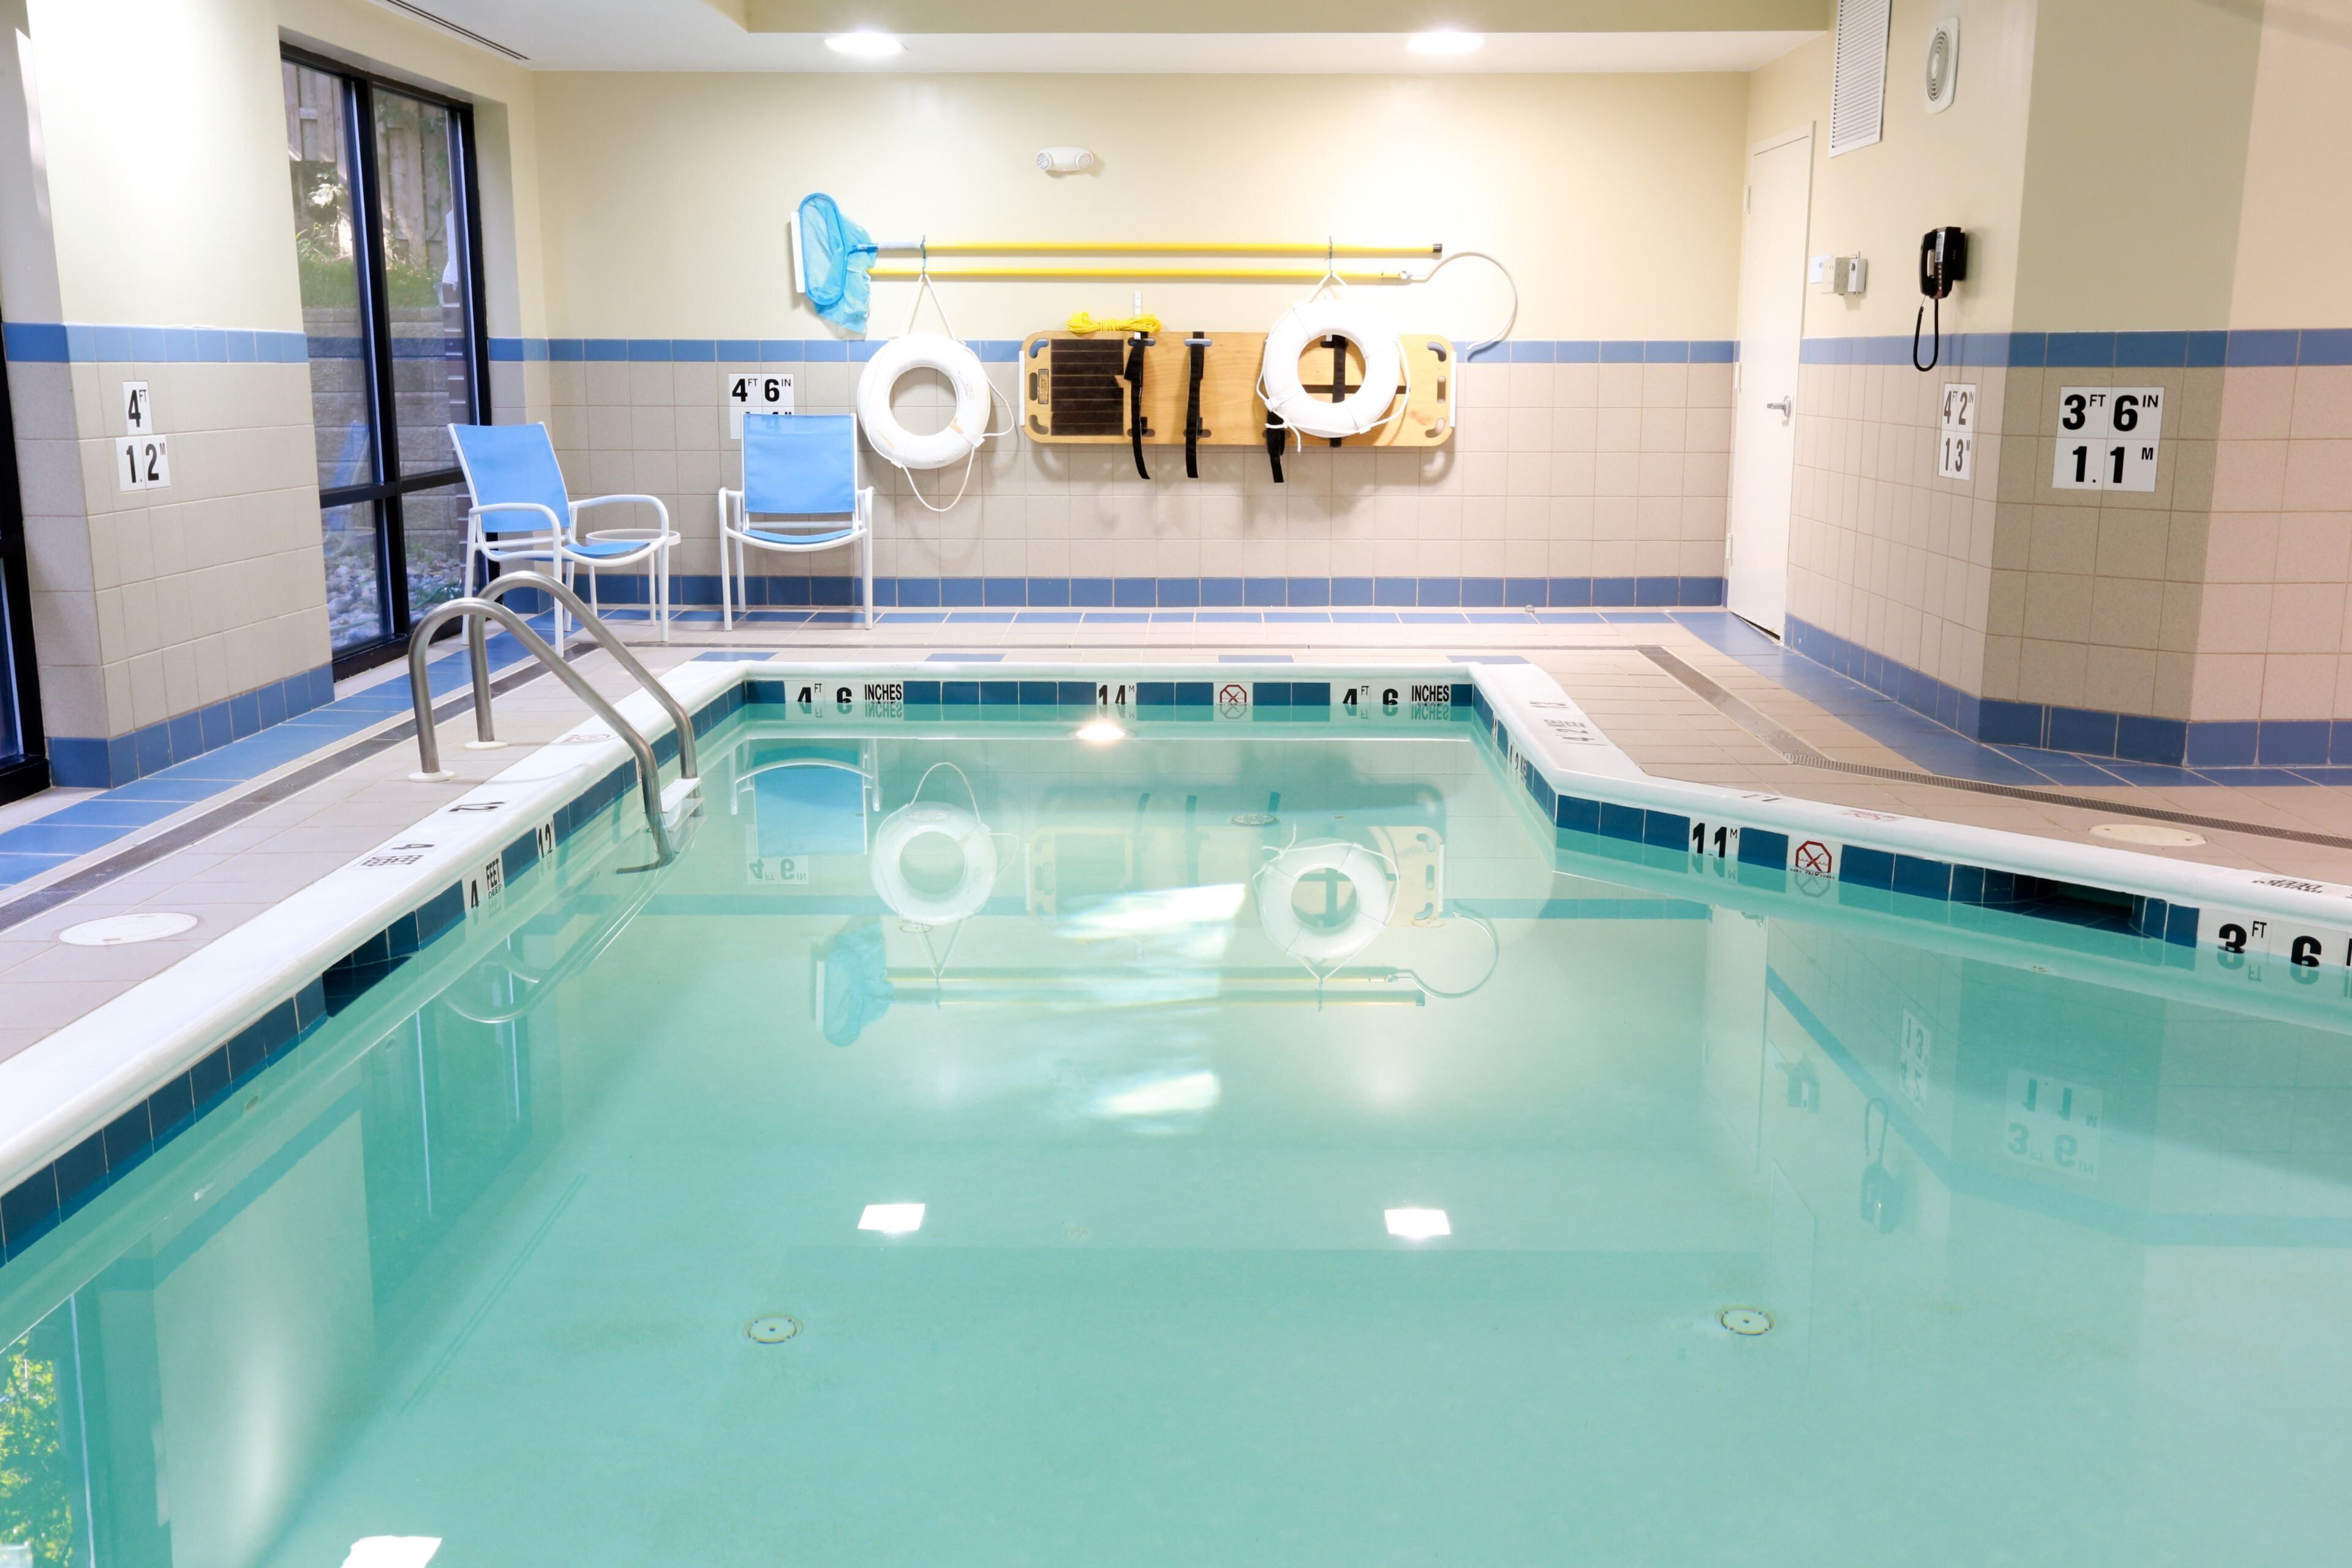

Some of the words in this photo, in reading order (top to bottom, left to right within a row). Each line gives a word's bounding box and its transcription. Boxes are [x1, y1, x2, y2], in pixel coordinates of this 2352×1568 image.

[732, 379, 748, 402] 4
[764, 379, 780, 402] 6
[128, 390, 141, 428] 4
[1958, 391, 1968, 425] 2
[2062, 394, 2087, 430] 3
[2089, 394, 2106, 407] FT
[2113, 394, 2139, 432] 6
[2142, 394, 2158, 407] IN
[2141, 447, 2154, 460] M
[864, 684, 902, 701] INCHES
[1411, 685, 1450, 703] INCHES
[1730, 828, 1738, 840] M
[486, 858, 500, 891] FEET
[2251, 921, 2267, 938] FT
